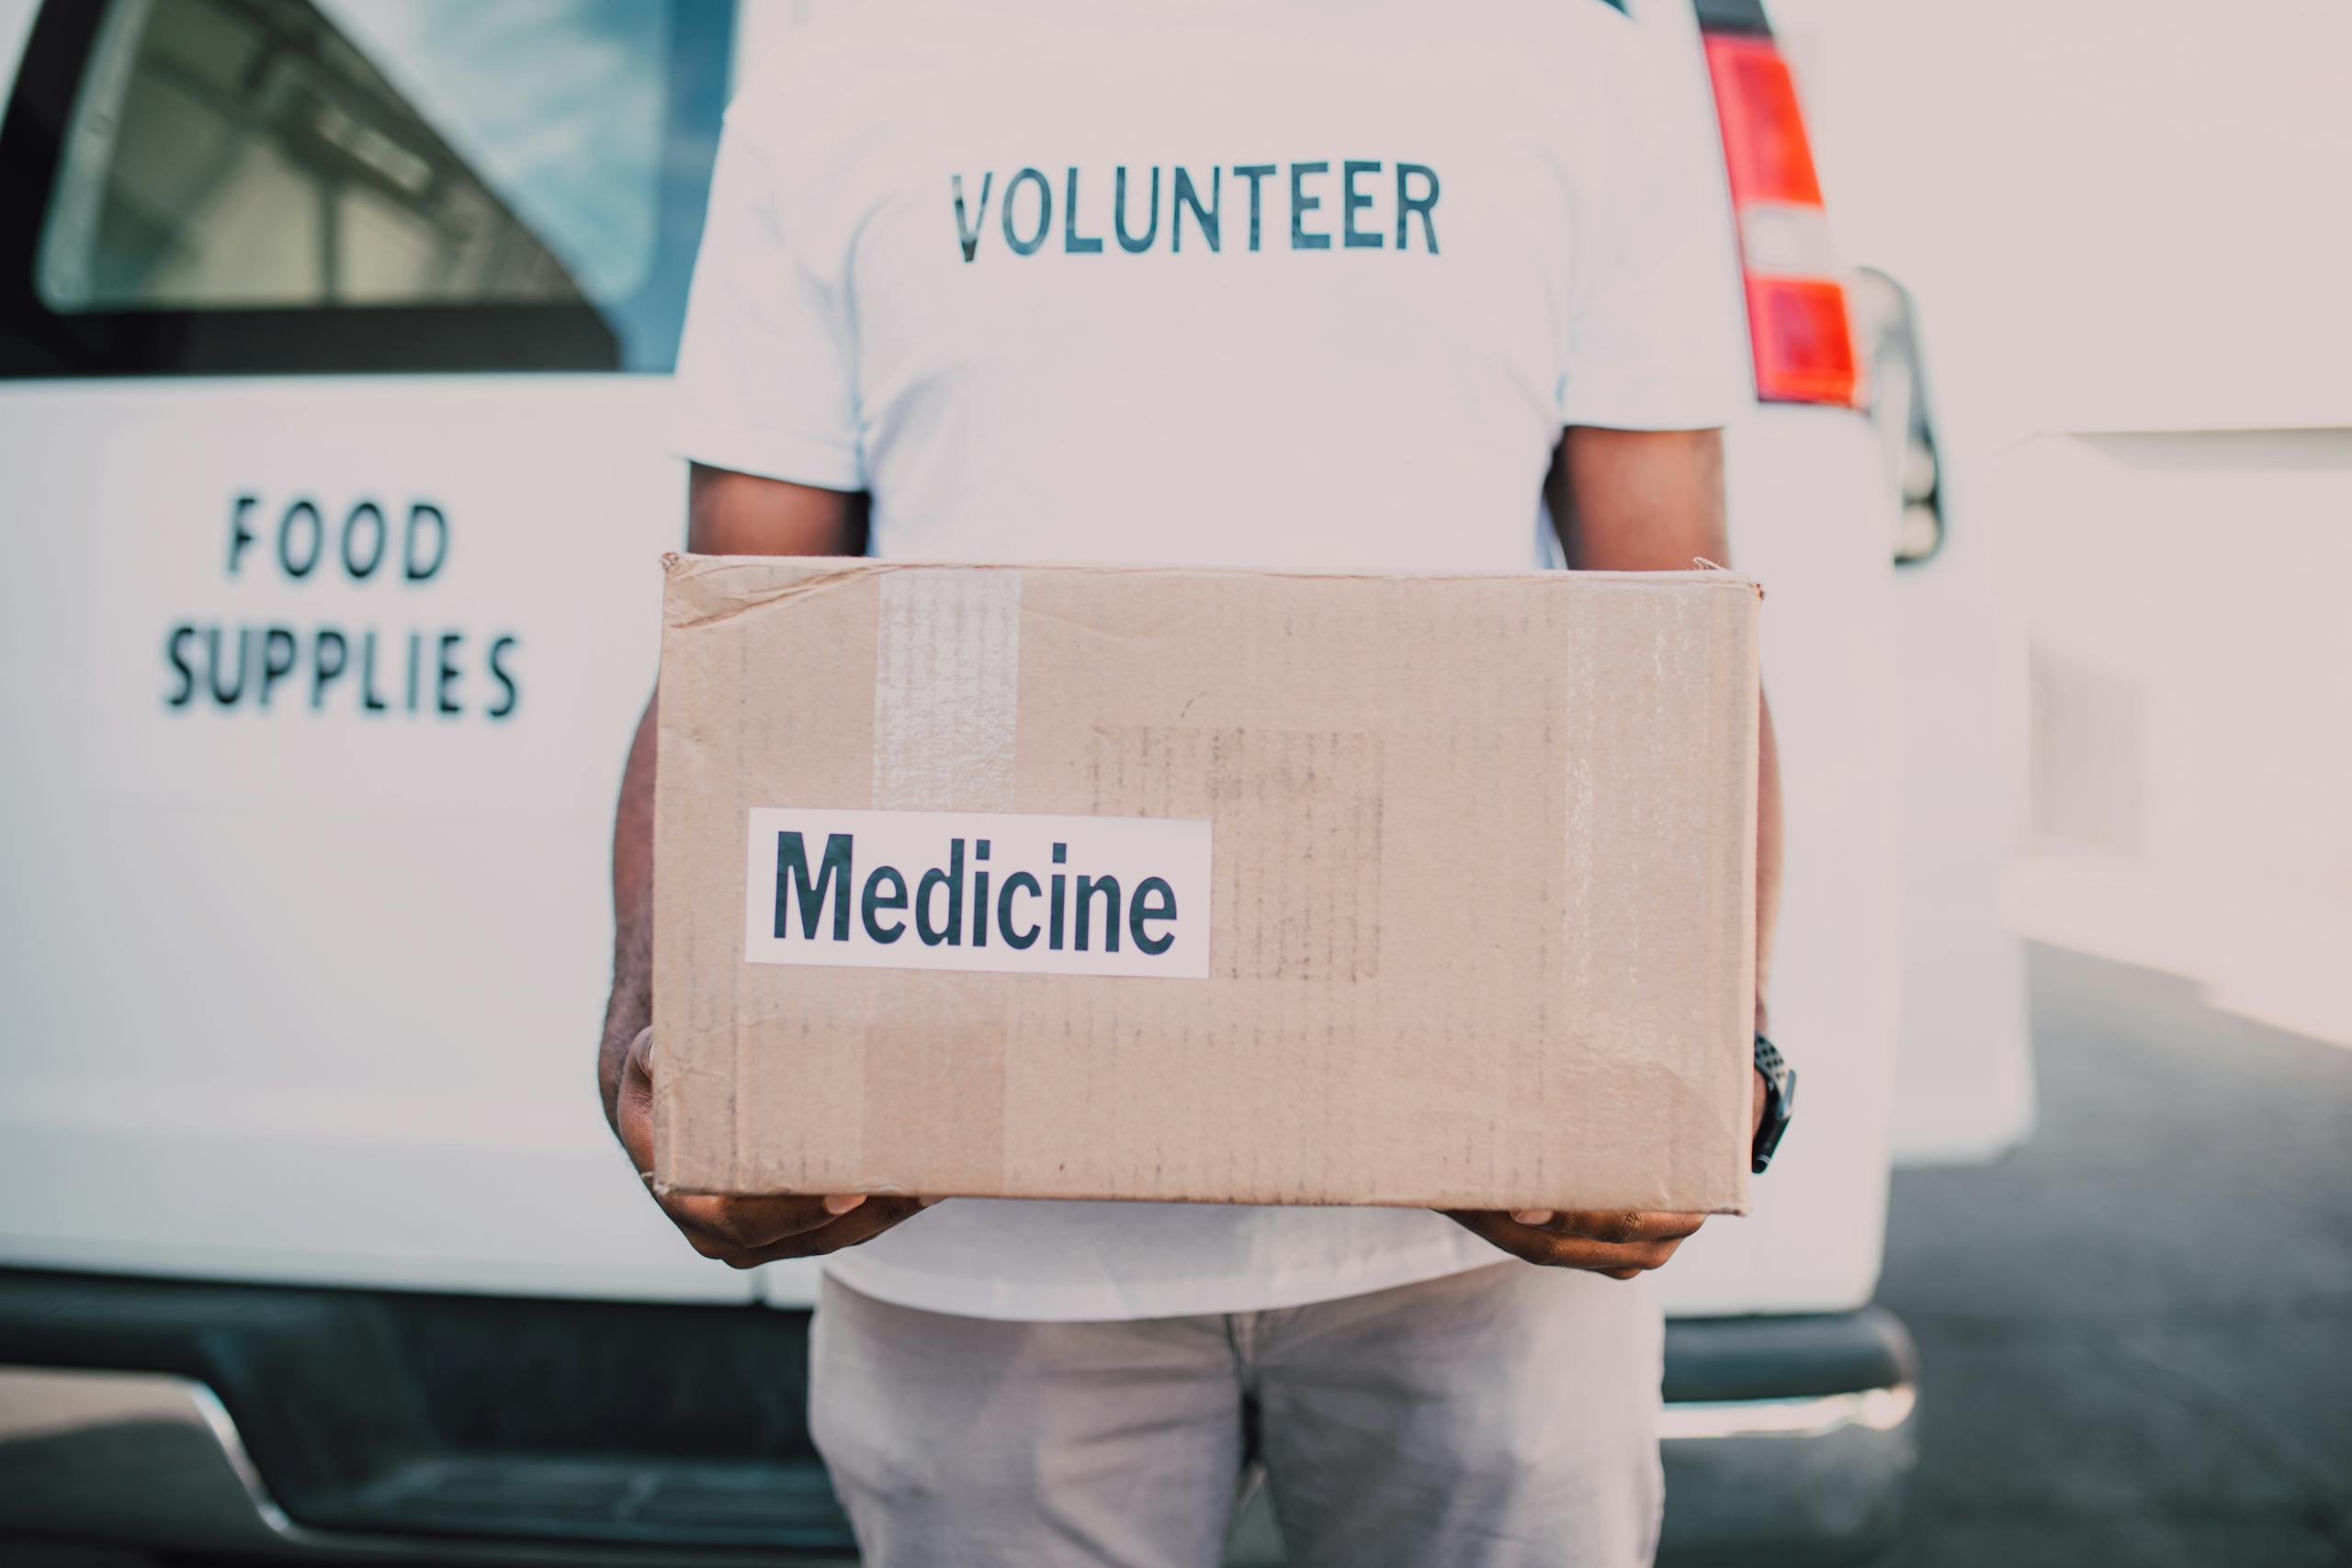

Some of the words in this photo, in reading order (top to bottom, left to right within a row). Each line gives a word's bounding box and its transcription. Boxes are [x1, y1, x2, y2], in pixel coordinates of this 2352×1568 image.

[953, 160, 1441, 263] VOLUNTEER
[228, 494, 448, 582] FOOD
[166, 624, 518, 719] SUPPLIES
[774, 831, 1177, 955] Medicine
